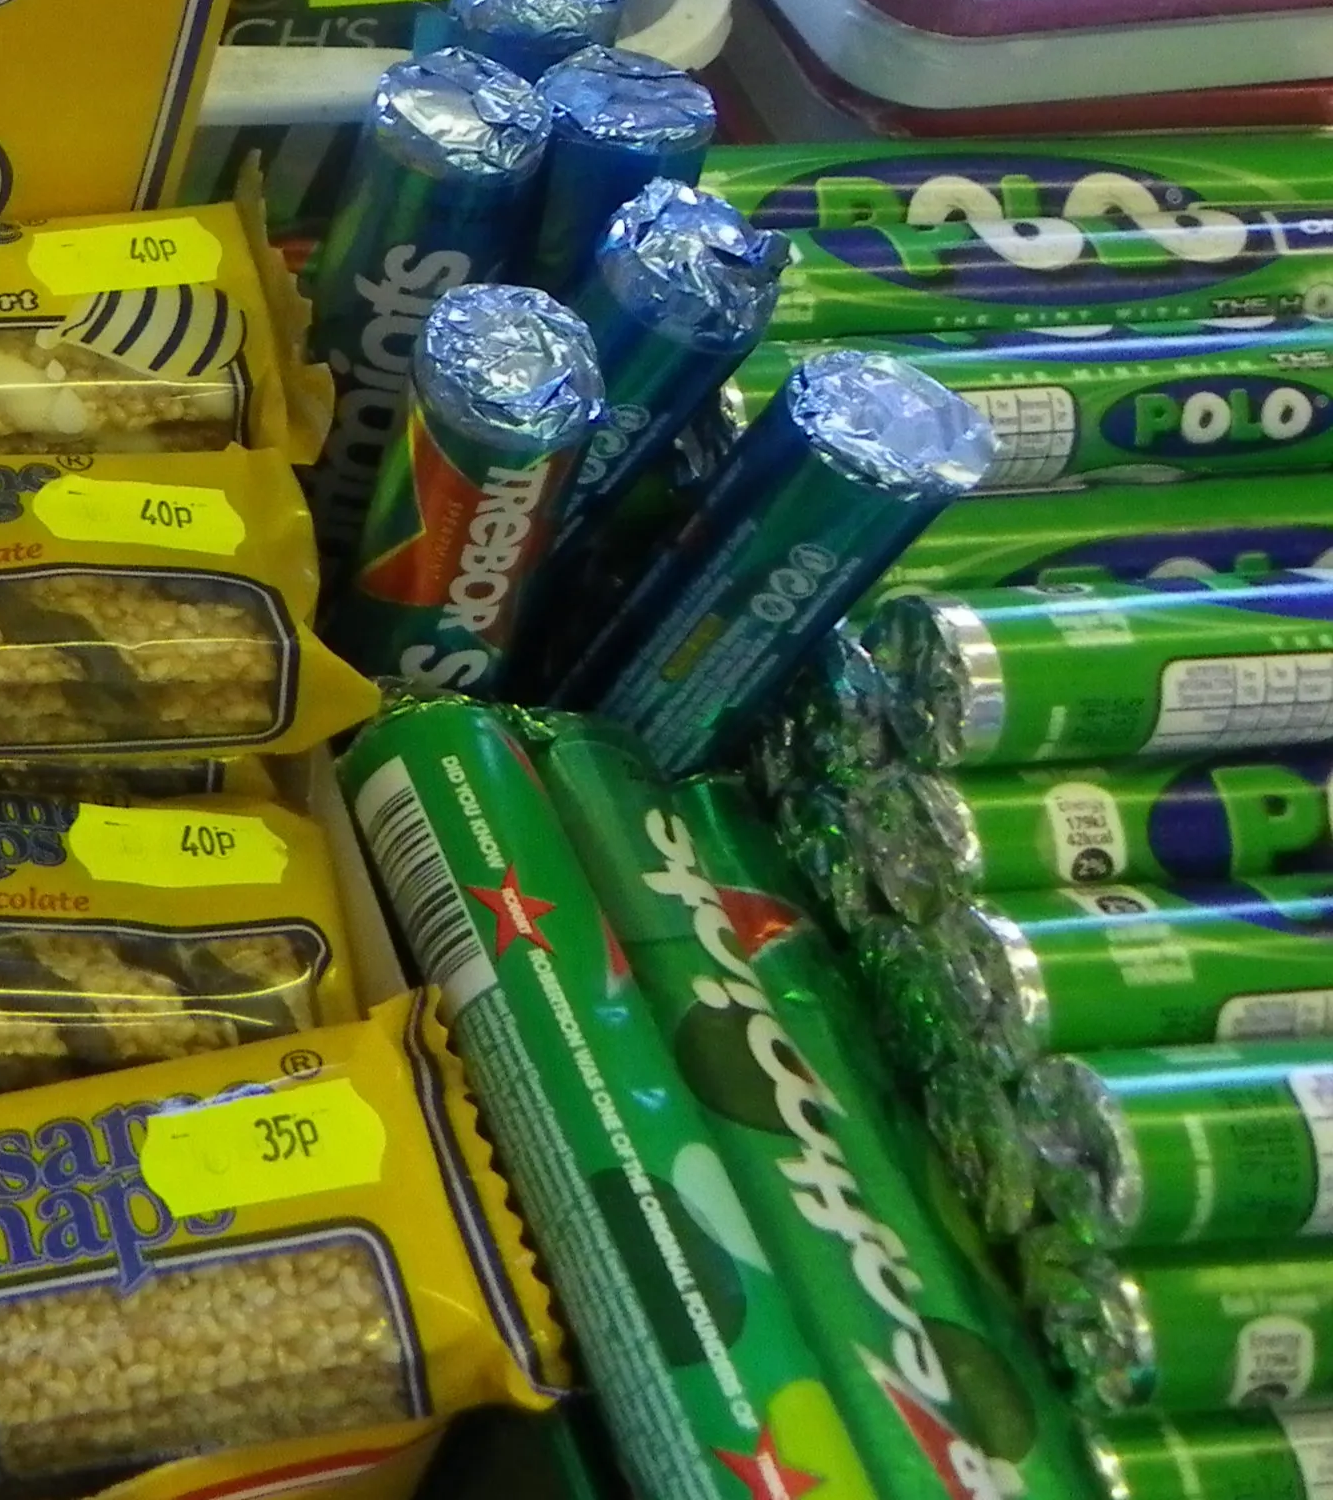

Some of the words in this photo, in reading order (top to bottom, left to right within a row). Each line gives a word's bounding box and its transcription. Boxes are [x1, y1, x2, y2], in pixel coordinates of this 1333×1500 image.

[129, 235, 179, 263] 40p
[1014, 309, 1091, 325] MINT
[1135, 386, 1314, 448] POLO
[139, 498, 195, 531] 40p
[440, 753, 467, 784] DID
[454, 781, 483, 818] YOU
[179, 825, 237, 860] 40p
[468, 816, 507, 870] KNOW
[526, 946, 587, 1051] ROBERTSON
[573, 1042, 607, 1093] WAS
[591, 1089, 623, 1135] ONE
[253, 1118, 321, 1163] 35p
[620, 1156, 653, 1198] THE
[638, 1193, 694, 1294] ORIGINAL
